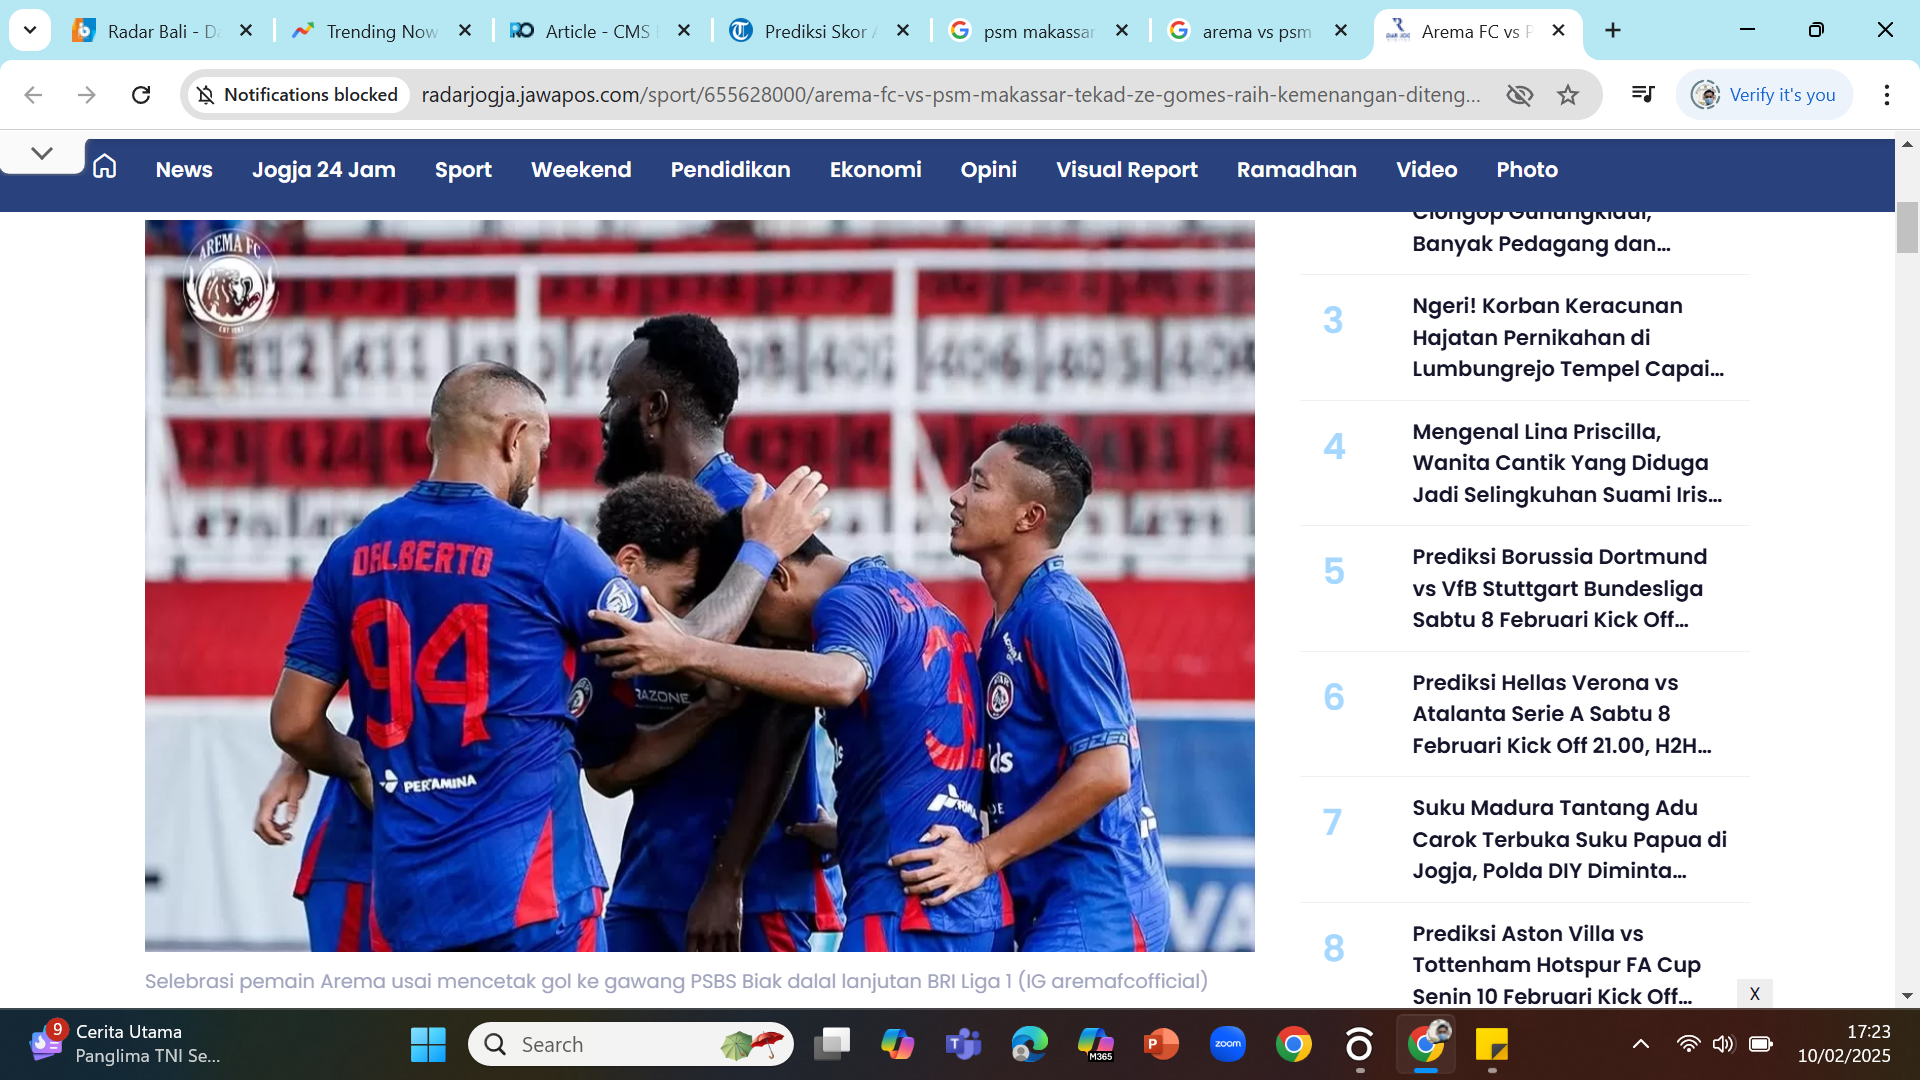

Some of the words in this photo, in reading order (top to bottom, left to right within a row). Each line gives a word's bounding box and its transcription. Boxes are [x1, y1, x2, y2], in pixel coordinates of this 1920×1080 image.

[108, 23, 155, 39] Radar
[159, 23, 187, 39] Bali
[326, 23, 396, 43] Trending
[403, 25, 439, 38] Now
[545, 23, 597, 39] Article
[613, 24, 650, 39] CMS
[765, 23, 827, 39] Prediksi
[831, 23, 868, 39] Skor
[984, 28, 1018, 43] psm
[1203, 28, 1253, 39] arema
[1256, 28, 1274, 39] vs
[1279, 28, 1311, 43] psm
[1421, 24, 1474, 39] Arema
[1479, 24, 1499, 39] FC
[1503, 28, 1520, 39] vs
[224, 86, 330, 102] Notifications
[334, 86, 398, 102] blocked
[1729, 86, 1775, 106] Verify
[1779, 87, 1802, 102] it's
[1806, 91, 1836, 106] you
[155, 161, 214, 179] News
[251, 159, 312, 184] Jogja
[316, 160, 344, 178] 24
[347, 161, 396, 179] Jam
[435, 161, 493, 184] Sport
[530, 160, 632, 179] Weekend
[671, 159, 791, 179] Pendidikan
[830, 159, 922, 179] Ekonomi
[960, 159, 1018, 184] Opini
[1055, 159, 1123, 179] Visual
[1127, 161, 1199, 184] Report
[1237, 160, 1358, 179] Ramadhan
[1395, 159, 1459, 179] Video
[1496, 160, 1559, 179] Photo
[1413, 234, 1494, 258] Banyak
[1499, 234, 1609, 258] Pedagang
[1613, 234, 1671, 252] dan...
[1413, 295, 1476, 320] Ngeri!
[1482, 296, 1560, 314] Korban
[1565, 297, 1683, 314] Keracunan
[1323, 305, 1343, 334] 3
[1413, 327, 1498, 352] Hajatan
[1504, 327, 1626, 346] Pernikahan
[1630, 327, 1651, 346] di
[1413, 358, 1555, 383] Lumbungrejo
[1559, 359, 1640, 383] Tempel
[1644, 358, 1725, 383] Capai...
[1413, 422, 1519, 446] Mengenal
[1525, 421, 1568, 440] Lina
[1573, 421, 1662, 443] Priscilla,
[1323, 432, 1346, 460] 4
[1412, 452, 1490, 471] Wanita
[1495, 452, 1567, 471] Cantik
[1570, 454, 1626, 477] Yang
[1632, 452, 1709, 477] Diduga
[1412, 484, 1459, 503] Jadi
[1464, 484, 1597, 509] Selingkuhan
[1602, 484, 1671, 503] Suami
[1677, 484, 1723, 503] Iris...
[352, 540, 494, 578] DALBERTO
[1413, 546, 1496, 565] Prediksi
[1502, 546, 1593, 565] Borussia
[1599, 547, 1708, 565] Dortmund
[1324, 556, 1345, 585] 5
[1412, 583, 1437, 597] vs
[1441, 579, 1478, 597] VfB
[1482, 580, 1579, 603] Stuttgart
[1584, 578, 1703, 603] Bundesliga
[350, 598, 492, 749] 94
[1413, 672, 1496, 691] Prediksi
[1502, 673, 1567, 691] Hellas
[1571, 674, 1649, 691] Verona
[1654, 677, 1679, 691] vs
[1324, 682, 1345, 711] 6
[1412, 704, 1506, 722] Atalanta
[1511, 703, 1565, 722] Serie
[1569, 705, 1585, 722] A
[1589, 704, 1653, 722] Sabtu
[1657, 704, 1671, 723] 8
[403, 774, 477, 795] PERTAMINA
[1412, 798, 1465, 816] Suku
[1471, 798, 1554, 816] Madura
[1559, 799, 1650, 822] Tantang
[1654, 798, 1698, 816] Adu
[1322, 808, 1343, 836] 7
[1412, 830, 1478, 848] Carok
[1481, 830, 1570, 848] Terbuka
[1575, 830, 1628, 848] Suku
[1633, 831, 1702, 854] Papua
[1707, 829, 1727, 848] di
[1412, 860, 1478, 885] Jogja,
[1483, 861, 1543, 879] Polda
[1548, 862, 1583, 879] DIY
[1588, 860, 1687, 879] Diminta...
[1413, 923, 1496, 942] Prediksi
[1501, 925, 1563, 942] Aston
[1568, 923, 1615, 942] Villa
[1619, 928, 1644, 942] vs
[1323, 933, 1345, 963] 8
[1412, 955, 1531, 973] Tottenham
[1537, 956, 1622, 979] Hotspur
[1626, 956, 1653, 973] FA
[1656, 956, 1702, 979] Cup
[145, 972, 234, 989] Selebrasi
[240, 972, 315, 994] pemain
[320, 973, 386, 989] Arema
[391, 972, 432, 989] usai
[437, 972, 537, 989] mencetak
[541, 972, 571, 994] gol
[577, 972, 600, 989] ke
[604, 976, 685, 994] gawang
[691, 973, 737, 989] PSBS
[742, 972, 783, 989] Biak
[787, 972, 836, 989] dalal
[842, 972, 922, 994] lanjutan
[928, 973, 956, 989] BRI
[961, 972, 1000, 994] Liga
[1005, 973, 1011, 989] 1
[1018, 969, 1047, 993] (IG
[1051, 969, 1208, 993] aremafcofficial)
[1749, 986, 1761, 1001] X
[53, 1022, 63, 1036] 9
[76, 1024, 124, 1039] Cerita
[129, 1024, 182, 1039] Utama
[1848, 1024, 1891, 1039] 17:23
[522, 1035, 583, 1053] Search
[1215, 1040, 1242, 1048] zoom
[76, 1048, 150, 1067] Panglima
[154, 1048, 183, 1063] TNI
[188, 1048, 220, 1063] Se...
[1089, 1050, 1113, 1061] M365
[1798, 1048, 1891, 1065] 10/02/2025
